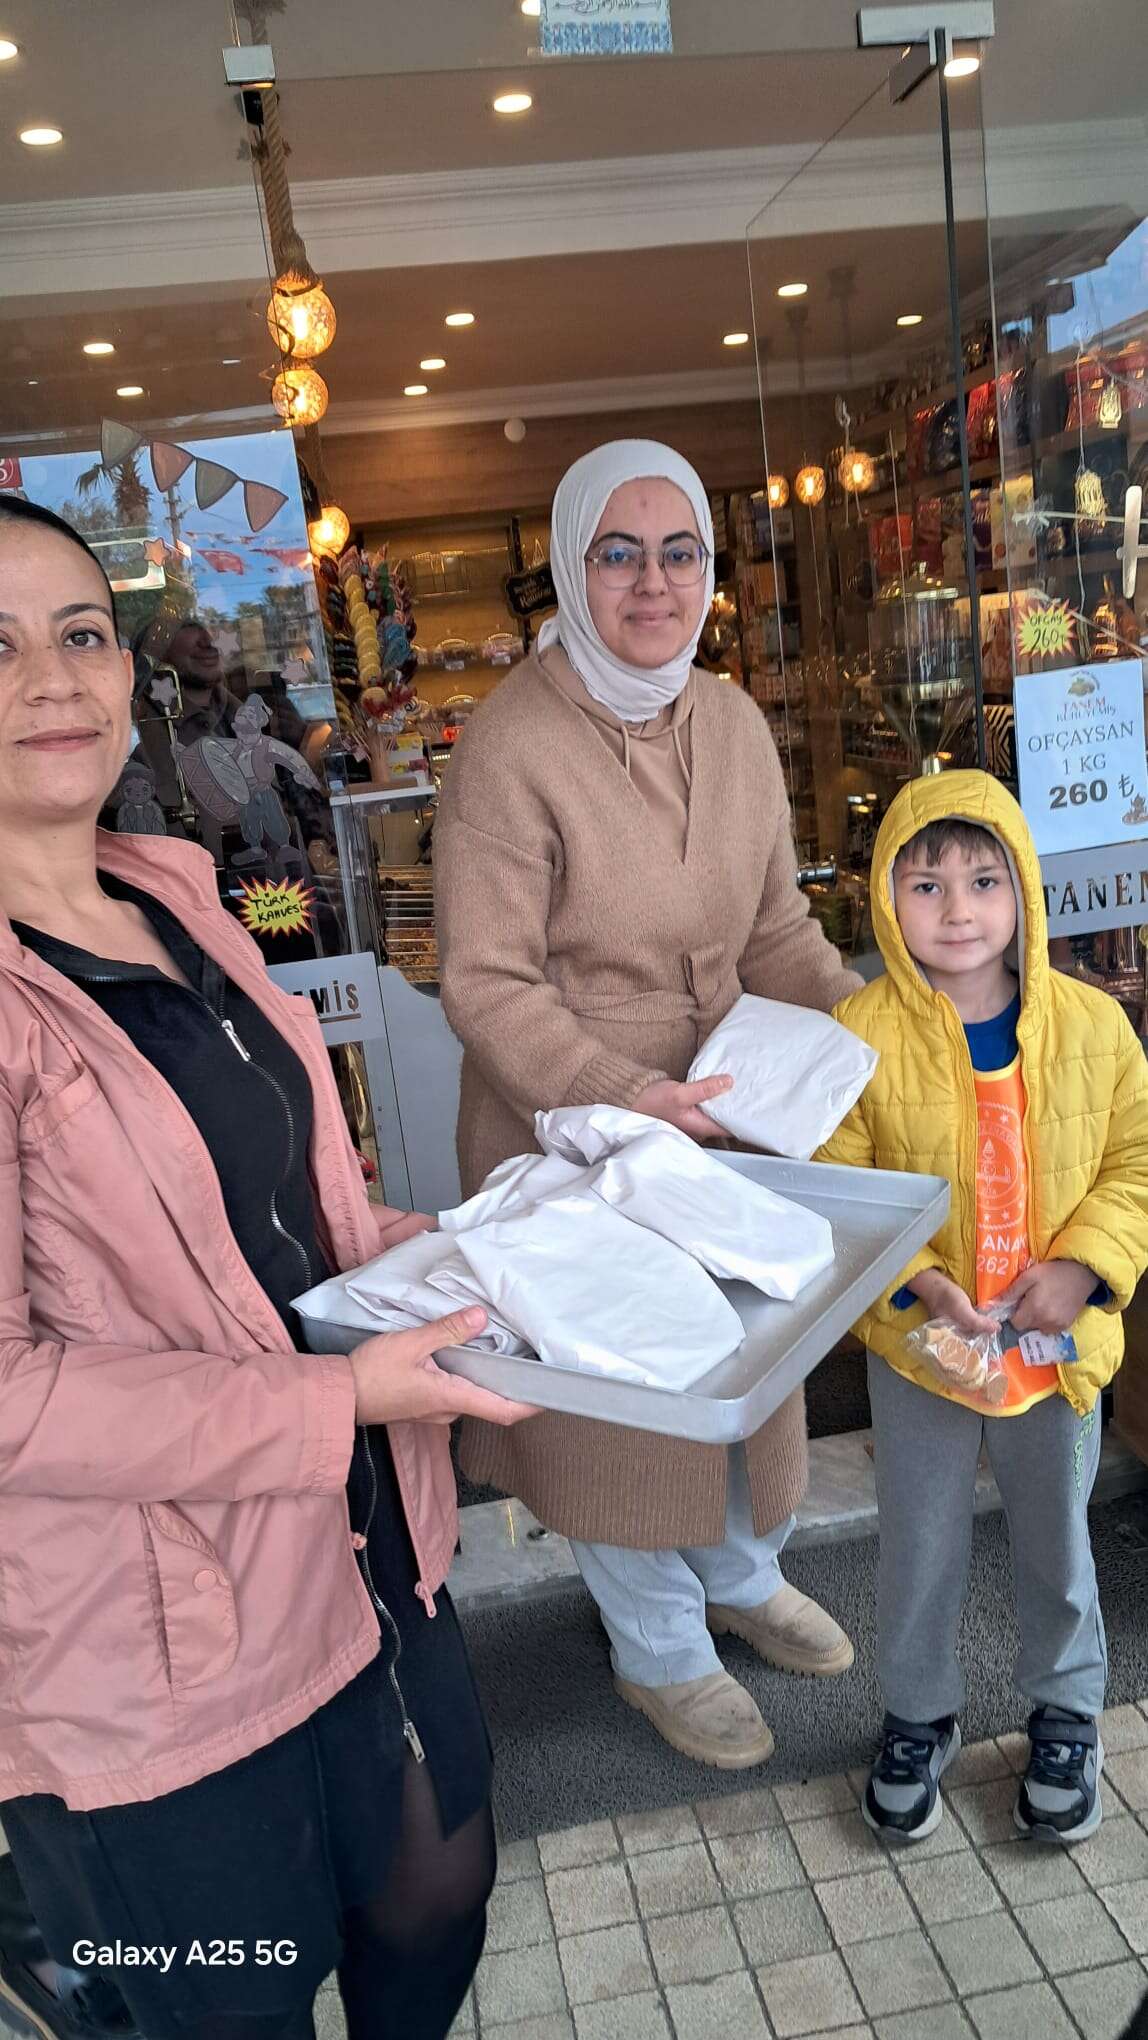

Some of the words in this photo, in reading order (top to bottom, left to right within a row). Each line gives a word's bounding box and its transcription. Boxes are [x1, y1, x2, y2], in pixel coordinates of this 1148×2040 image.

[1027, 720, 1134, 753] OFÇAYSAN
[1062, 757, 1070, 775] 1
[1080, 752, 1107, 774] KG
[1049, 779, 1109, 811] 260
[250, 892, 290, 911] TÜRK
[293, 979, 360, 1017] MİŞ
[976, 1254, 1009, 1275] 262
